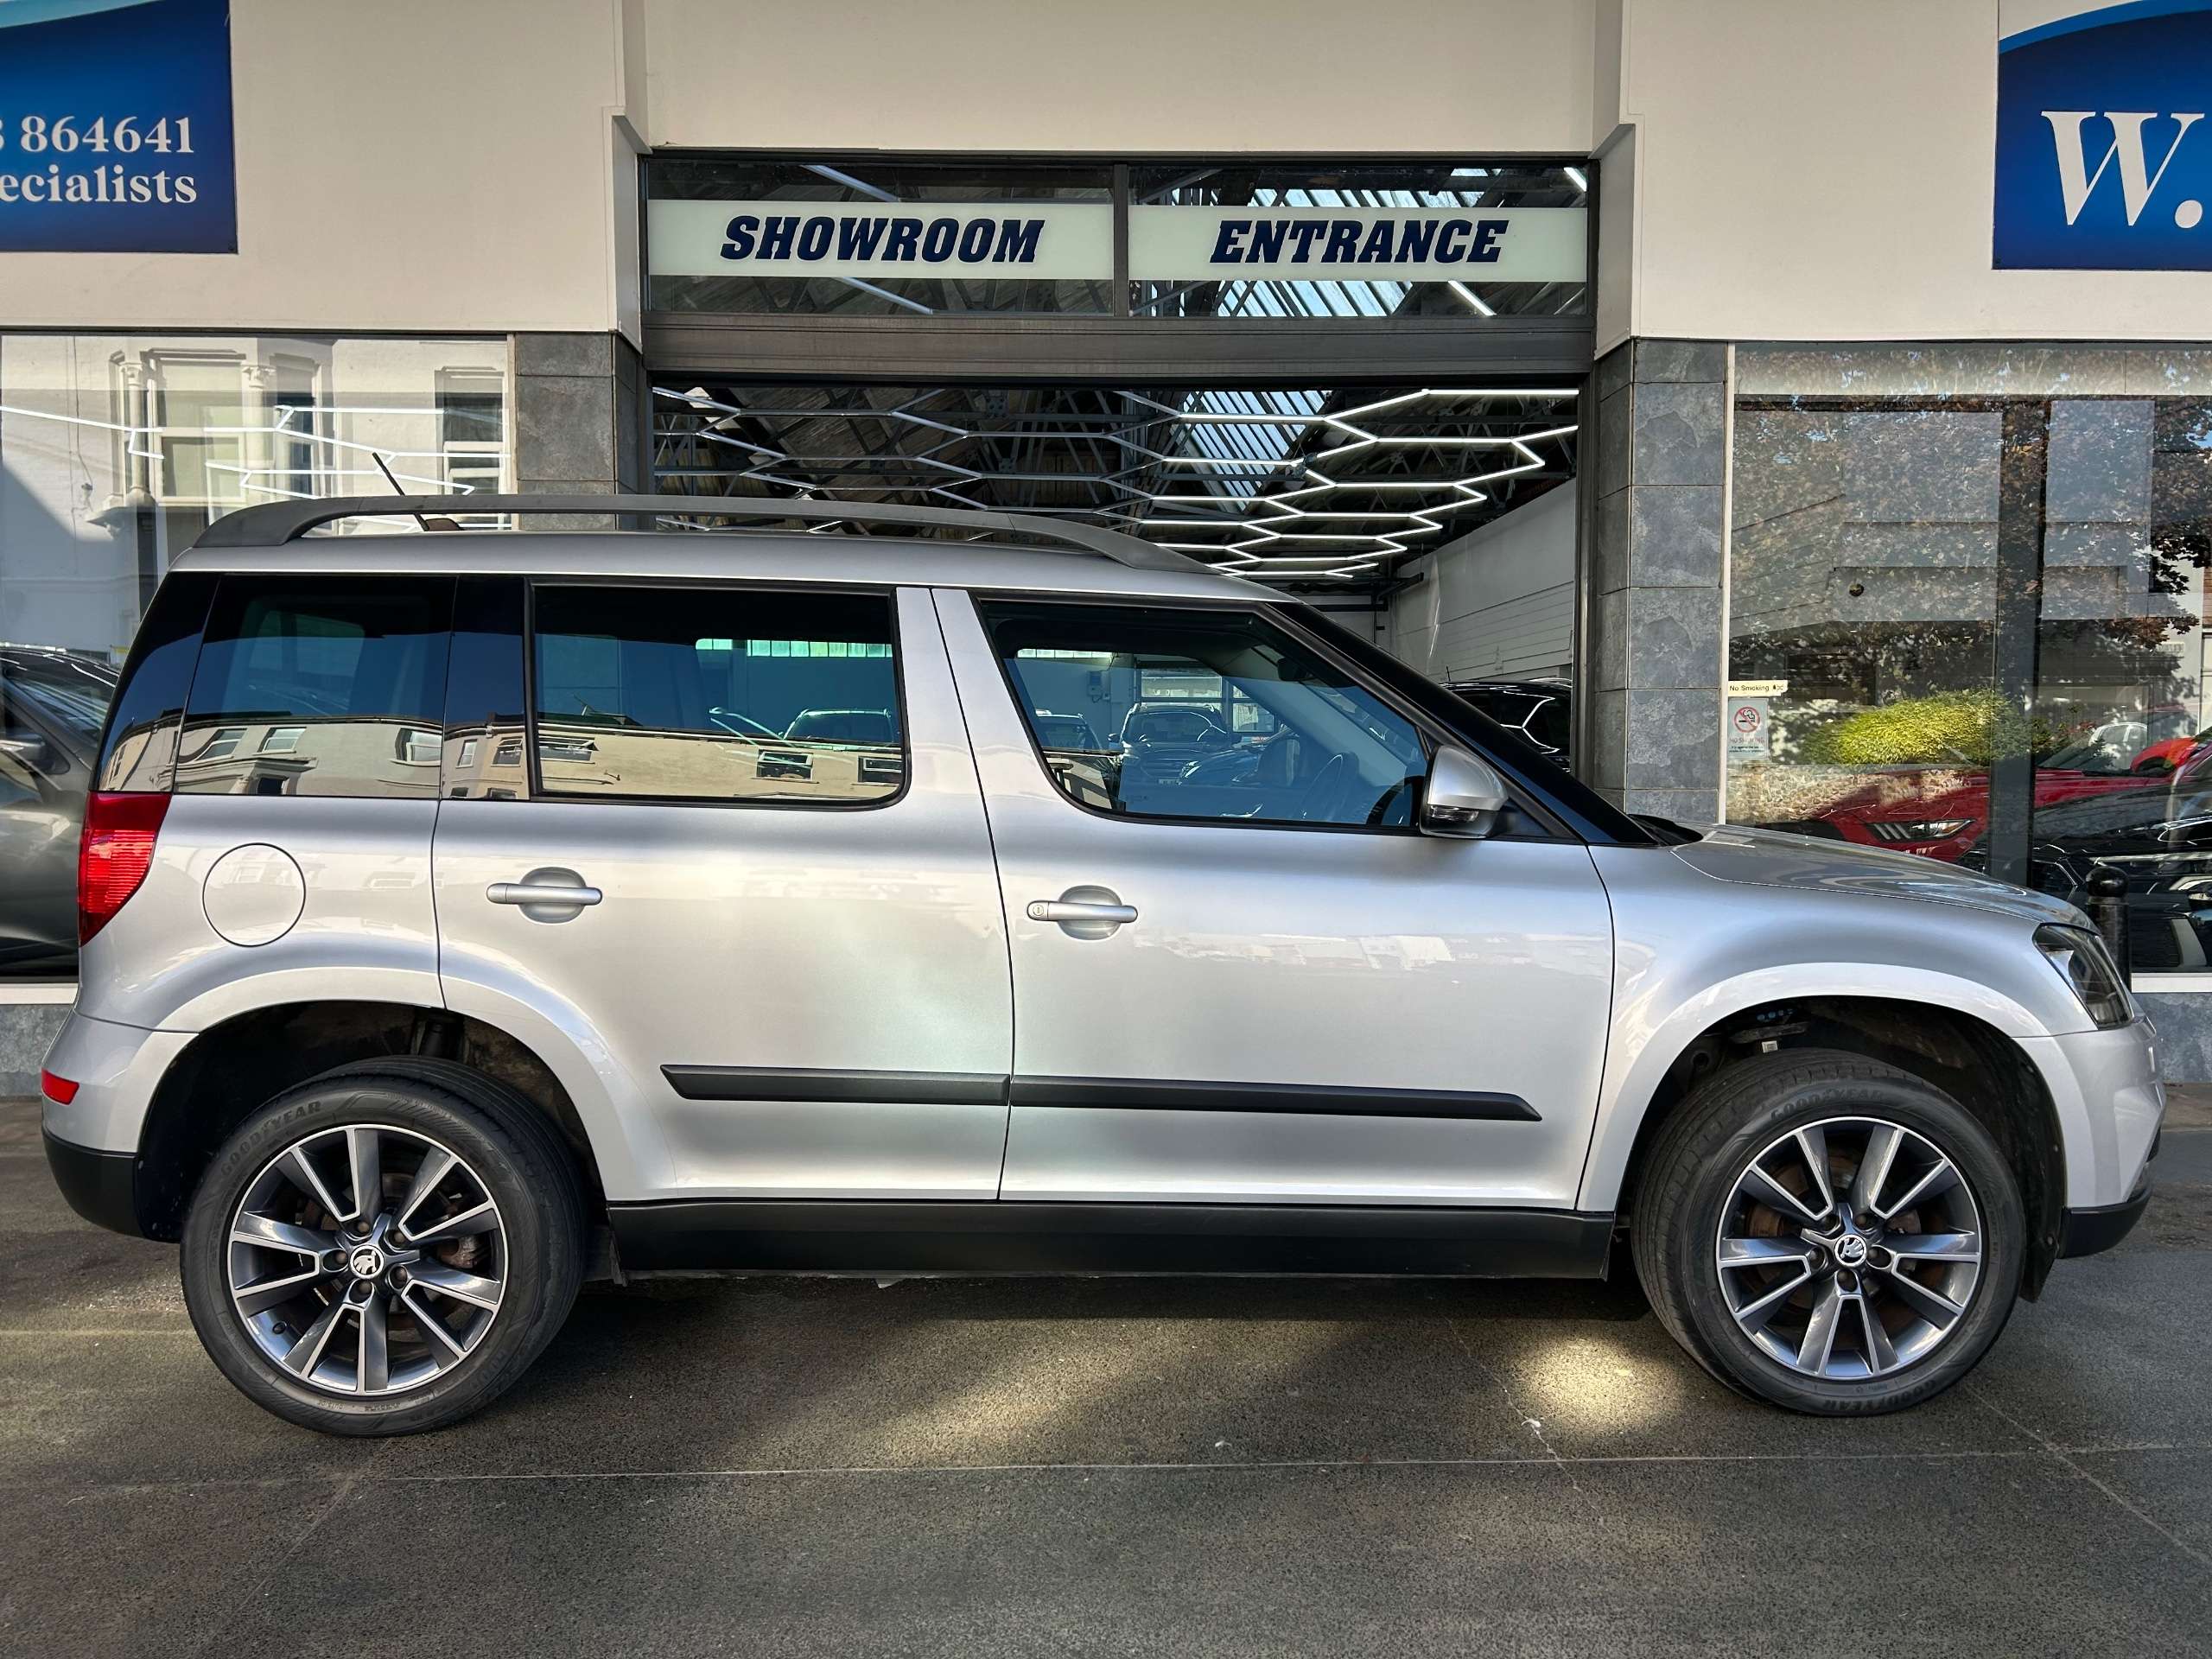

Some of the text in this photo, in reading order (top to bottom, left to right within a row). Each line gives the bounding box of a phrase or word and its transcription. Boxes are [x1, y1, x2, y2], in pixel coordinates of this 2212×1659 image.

[20, 115, 194, 154] 864641
[0, 163, 197, 204] ecialists
[2040, 111, 2205, 229] W.
[719, 215, 1510, 264] SHOWROOM ENTRANCE
[219, 1099, 322, 1177] GOODYEAR
